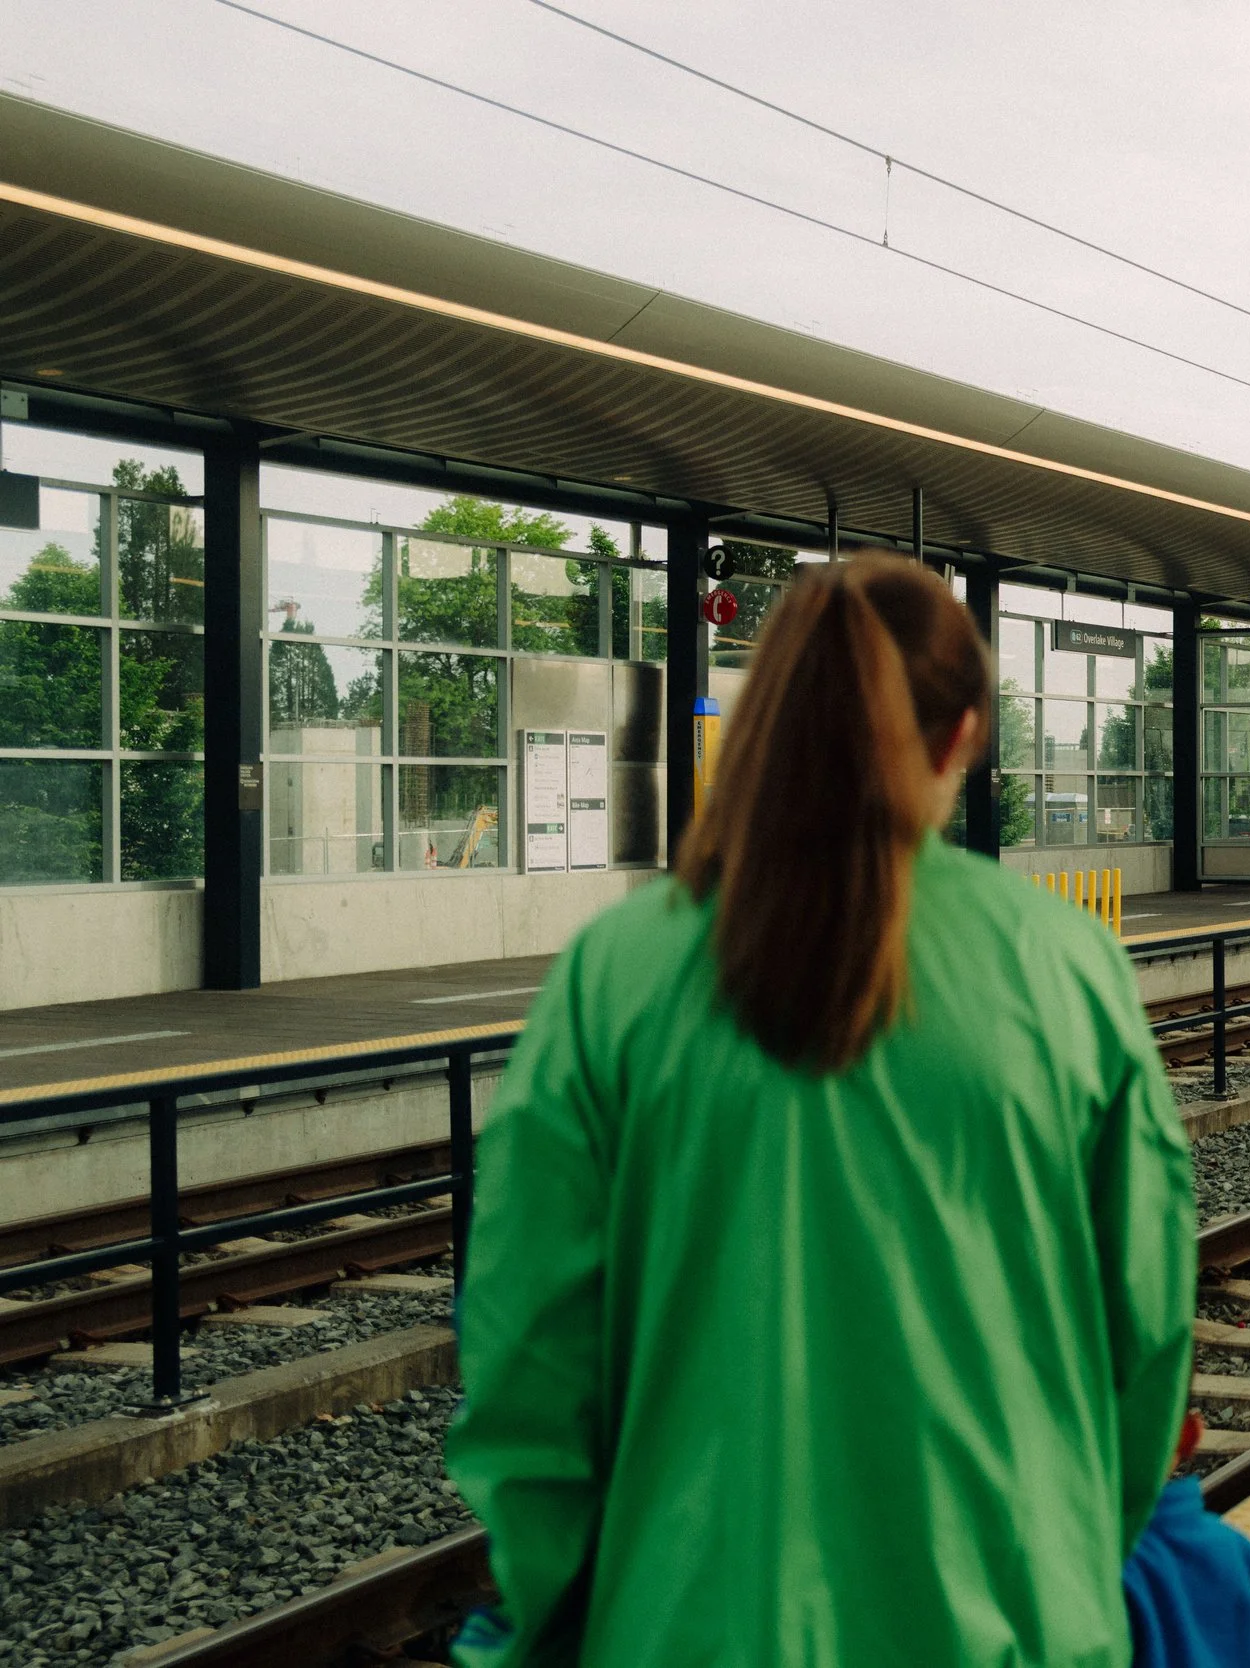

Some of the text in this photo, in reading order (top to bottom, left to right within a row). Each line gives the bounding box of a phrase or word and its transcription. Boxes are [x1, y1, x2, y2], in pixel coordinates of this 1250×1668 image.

[705, 590, 732, 605] EMERGENCY
[1083, 632, 1106, 646] Overlake
[1107, 635, 1124, 650] Village
